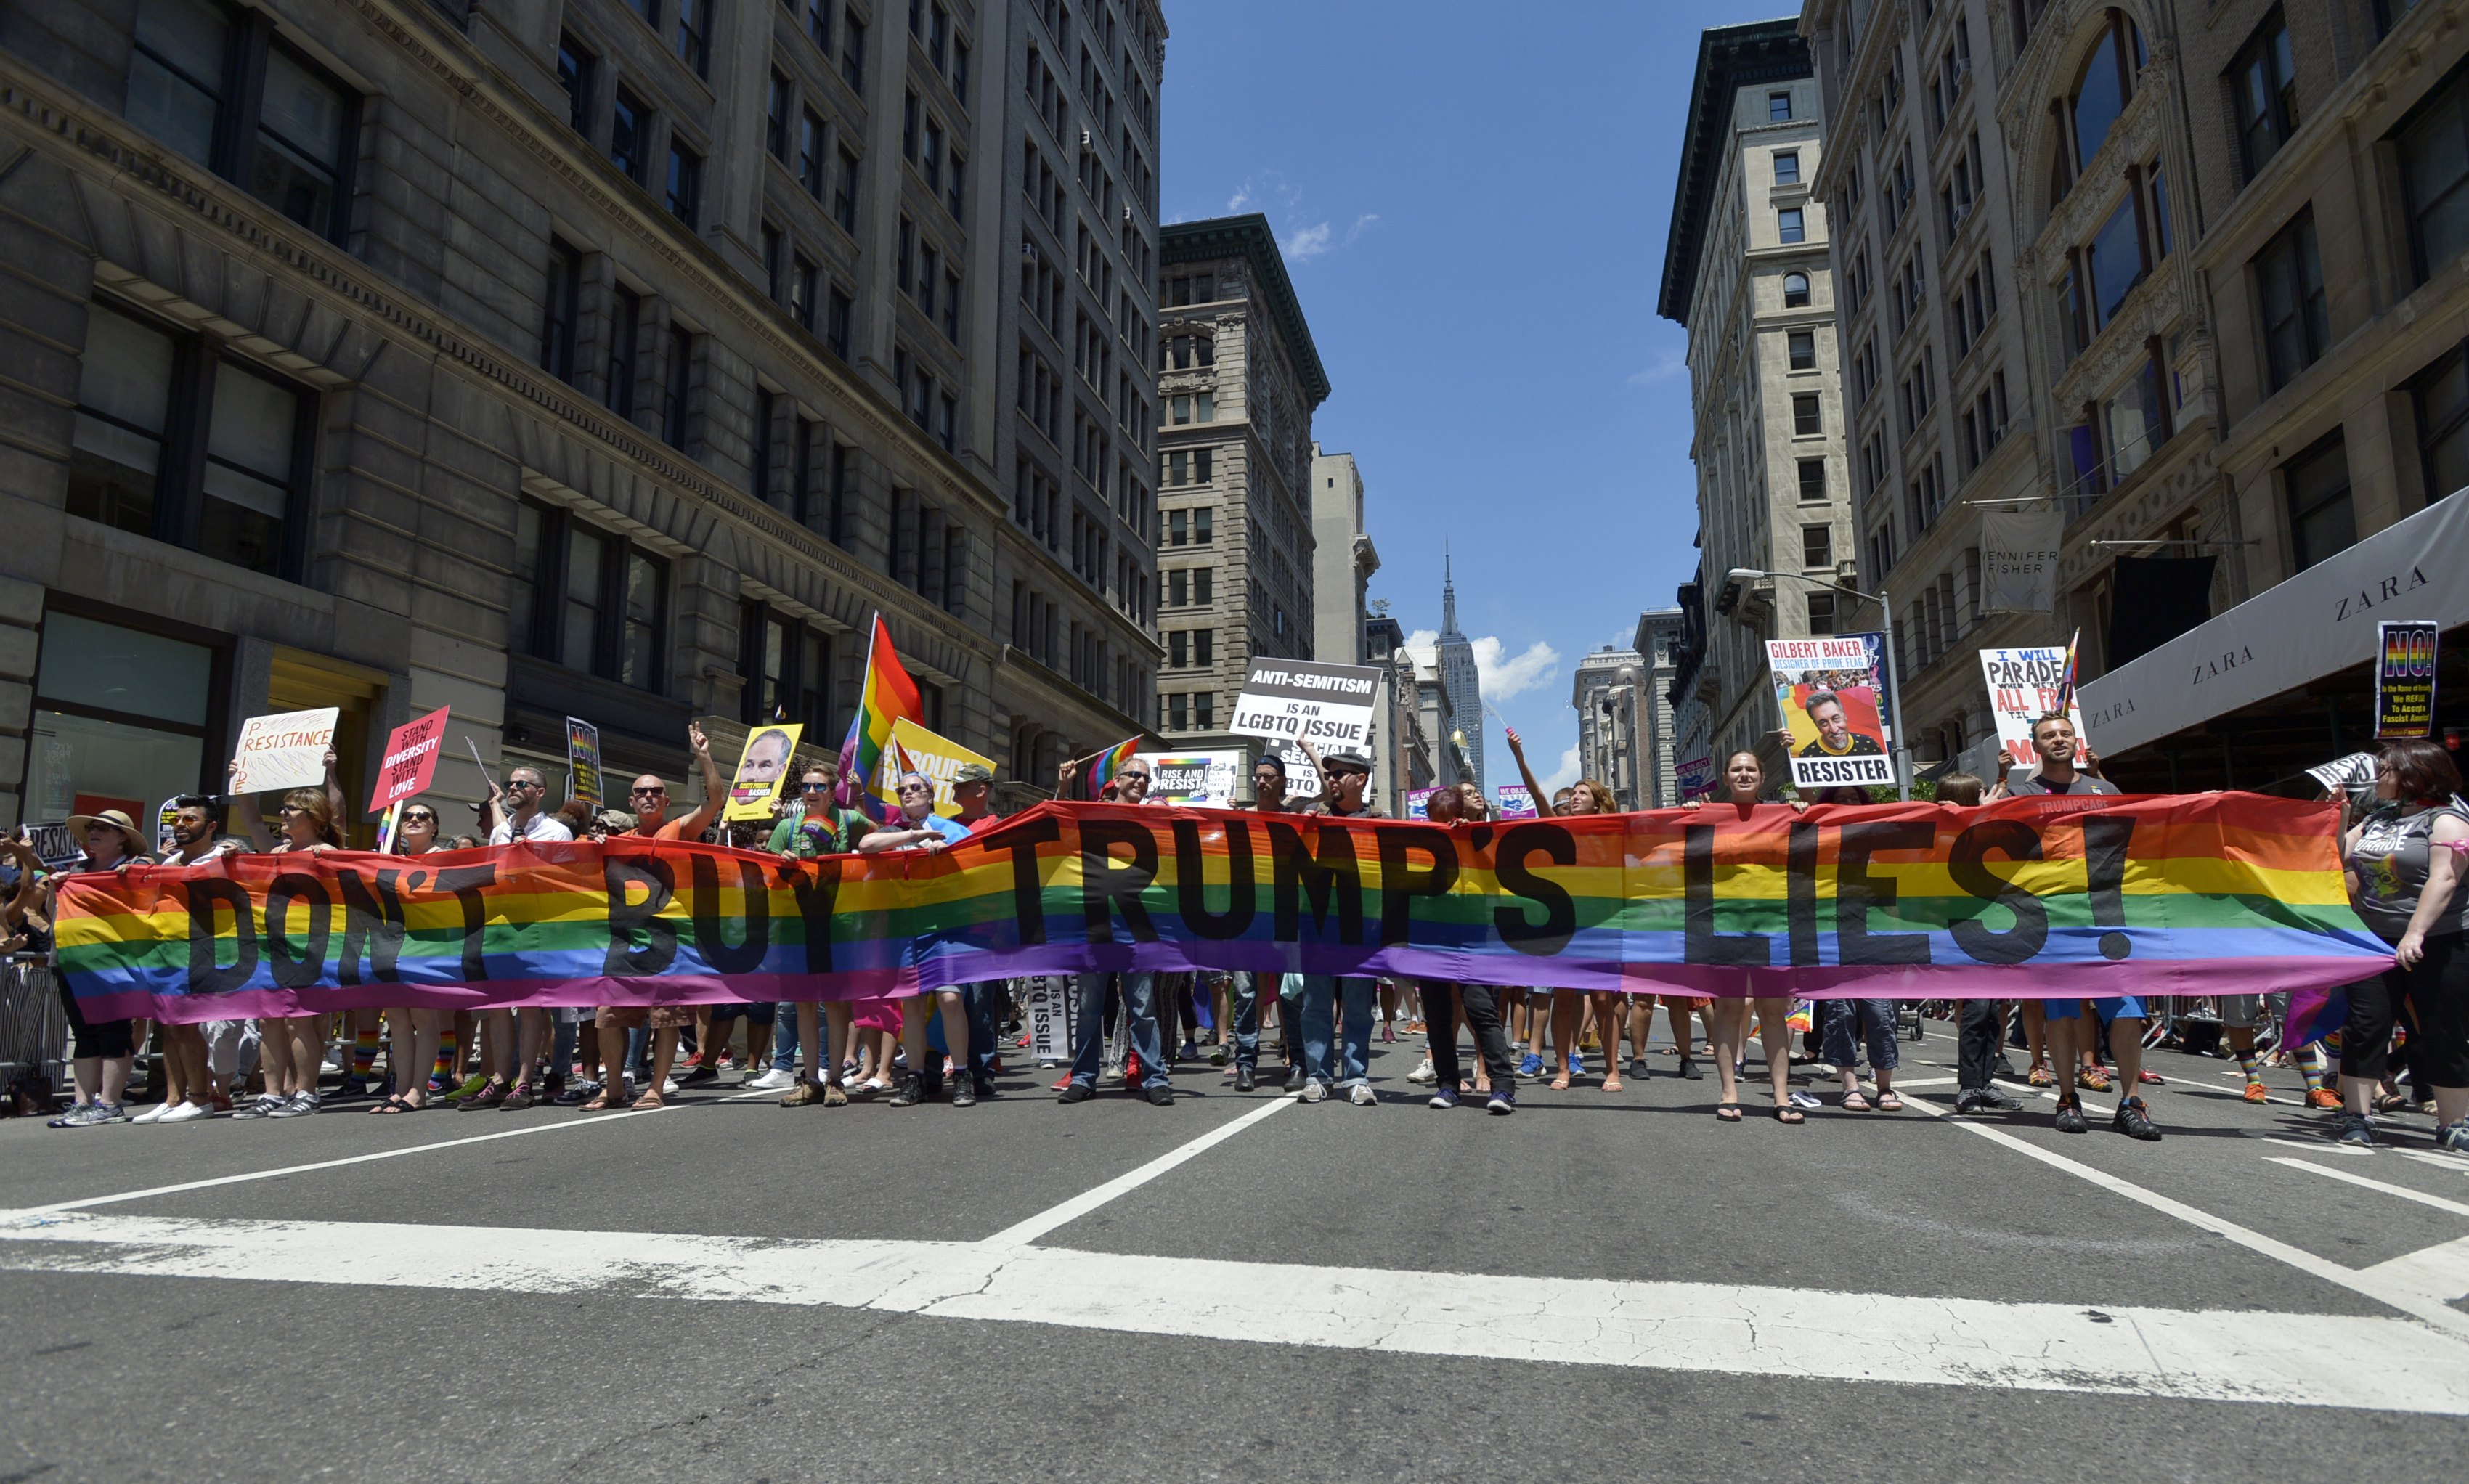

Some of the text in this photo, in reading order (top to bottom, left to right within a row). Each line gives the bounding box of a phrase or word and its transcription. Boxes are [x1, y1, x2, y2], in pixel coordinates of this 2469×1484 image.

[1982, 551, 2058, 561] JENNIFER
[1988, 563, 2043, 574] FISHER
[2335, 566, 2430, 622] ZARA
[1770, 641, 1819, 658] GILBERT
[1822, 640, 1862, 657] BAKER
[1996, 649, 2057, 661] I WILL
[2385, 629, 2434, 677] NO!
[1774, 657, 1864, 669] DESIGNER OF PRIDE FLAG
[1987, 661, 2062, 683] PARADE
[2192, 645, 2254, 685] ZARA
[1250, 669, 1372, 694] ANTI-SEMITISM
[1286, 703, 1320, 716] IS AN
[1997, 688, 2080, 712] ALL FR
[2091, 698, 2136, 728] ZARA
[401, 719, 434, 741] STAND
[1237, 712, 1362, 740] LGBTQ ISSUE
[244, 729, 333, 752] RESISTANCE
[402, 732, 428, 751] WITH
[571, 725, 597, 765] NO!
[1291, 740, 1346, 755] SCIAL
[384, 736, 439, 769] DIVERSITY
[391, 754, 424, 776] STAND
[392, 766, 419, 786] WITH
[1162, 769, 1204, 778] RISE AND
[1687, 760, 1708, 771] OBJECT
[1797, 759, 1889, 783] RESISTER
[2314, 754, 2373, 783] RESIS
[388, 778, 417, 799] LOVE
[1160, 778, 1203, 790] RESIST
[1188, 788, 1206, 799] .ORG
[1285, 779, 1314, 793] BTQ
[2037, 799, 2108, 814] TRUMPCARE
[2365, 823, 2415, 840] GY
[184, 815, 2138, 995] DON'T BUY TRUMP'S LIES!
[1050, 989, 1062, 1017] IS AN
[1032, 975, 1052, 1054] BTQ ISSUE
